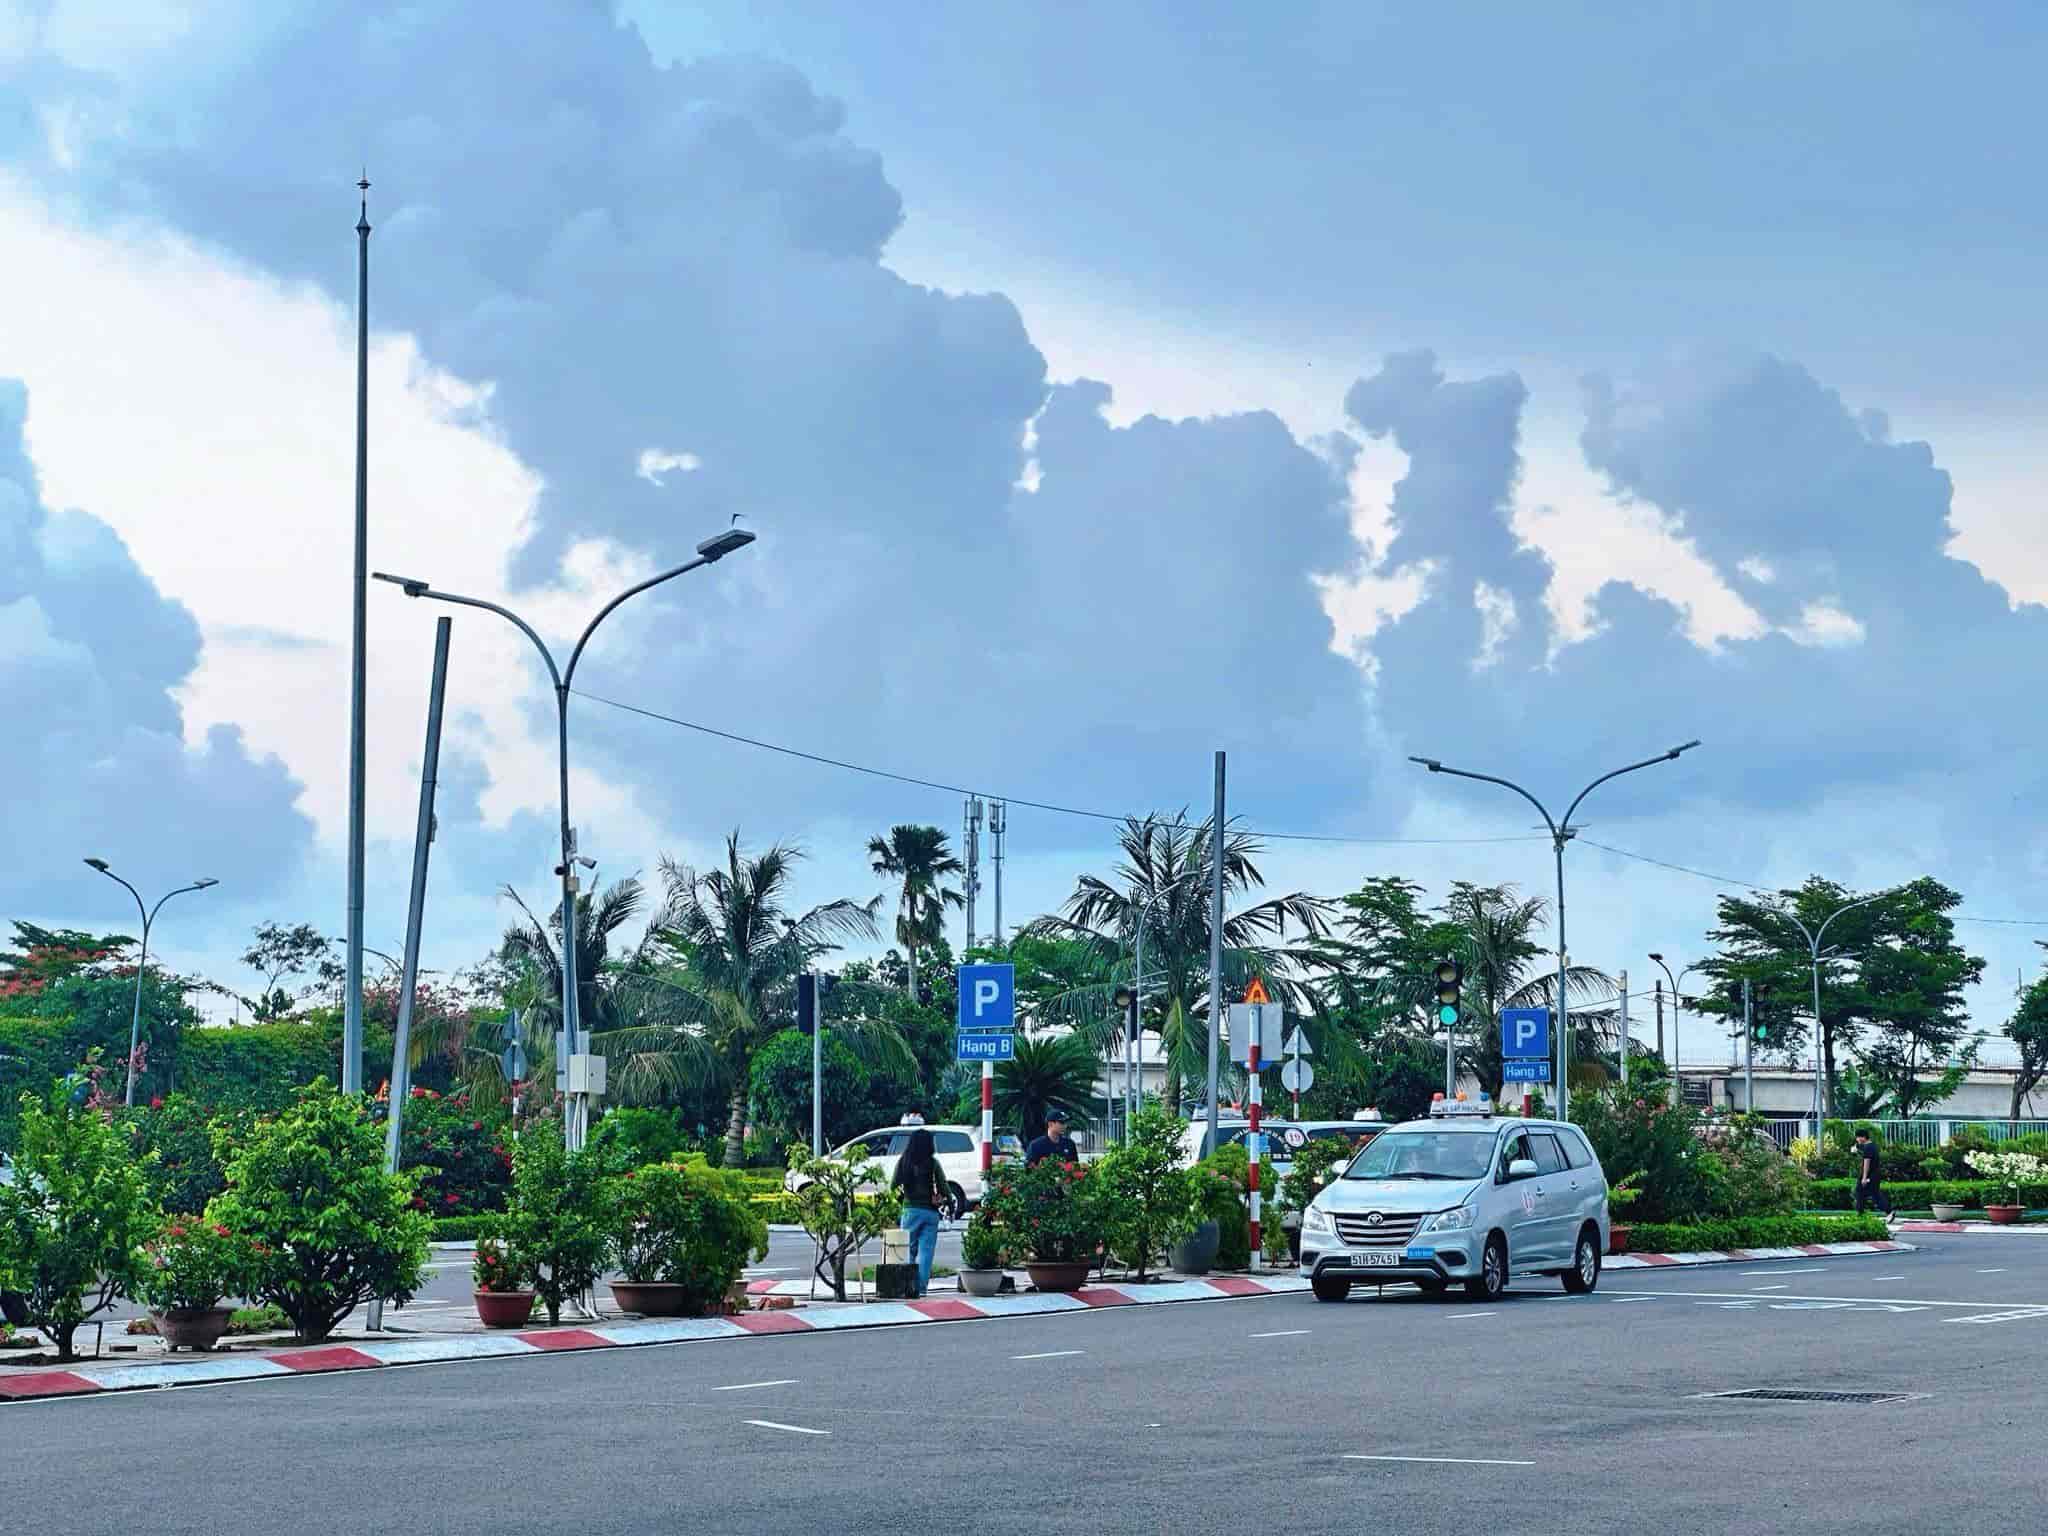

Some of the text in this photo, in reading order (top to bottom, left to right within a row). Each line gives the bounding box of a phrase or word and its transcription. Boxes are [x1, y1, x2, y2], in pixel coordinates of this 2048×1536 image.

[974, 980, 1000, 1016] P
[1001, 1039, 1010, 1053] B
[1516, 1020, 1537, 1049] P
